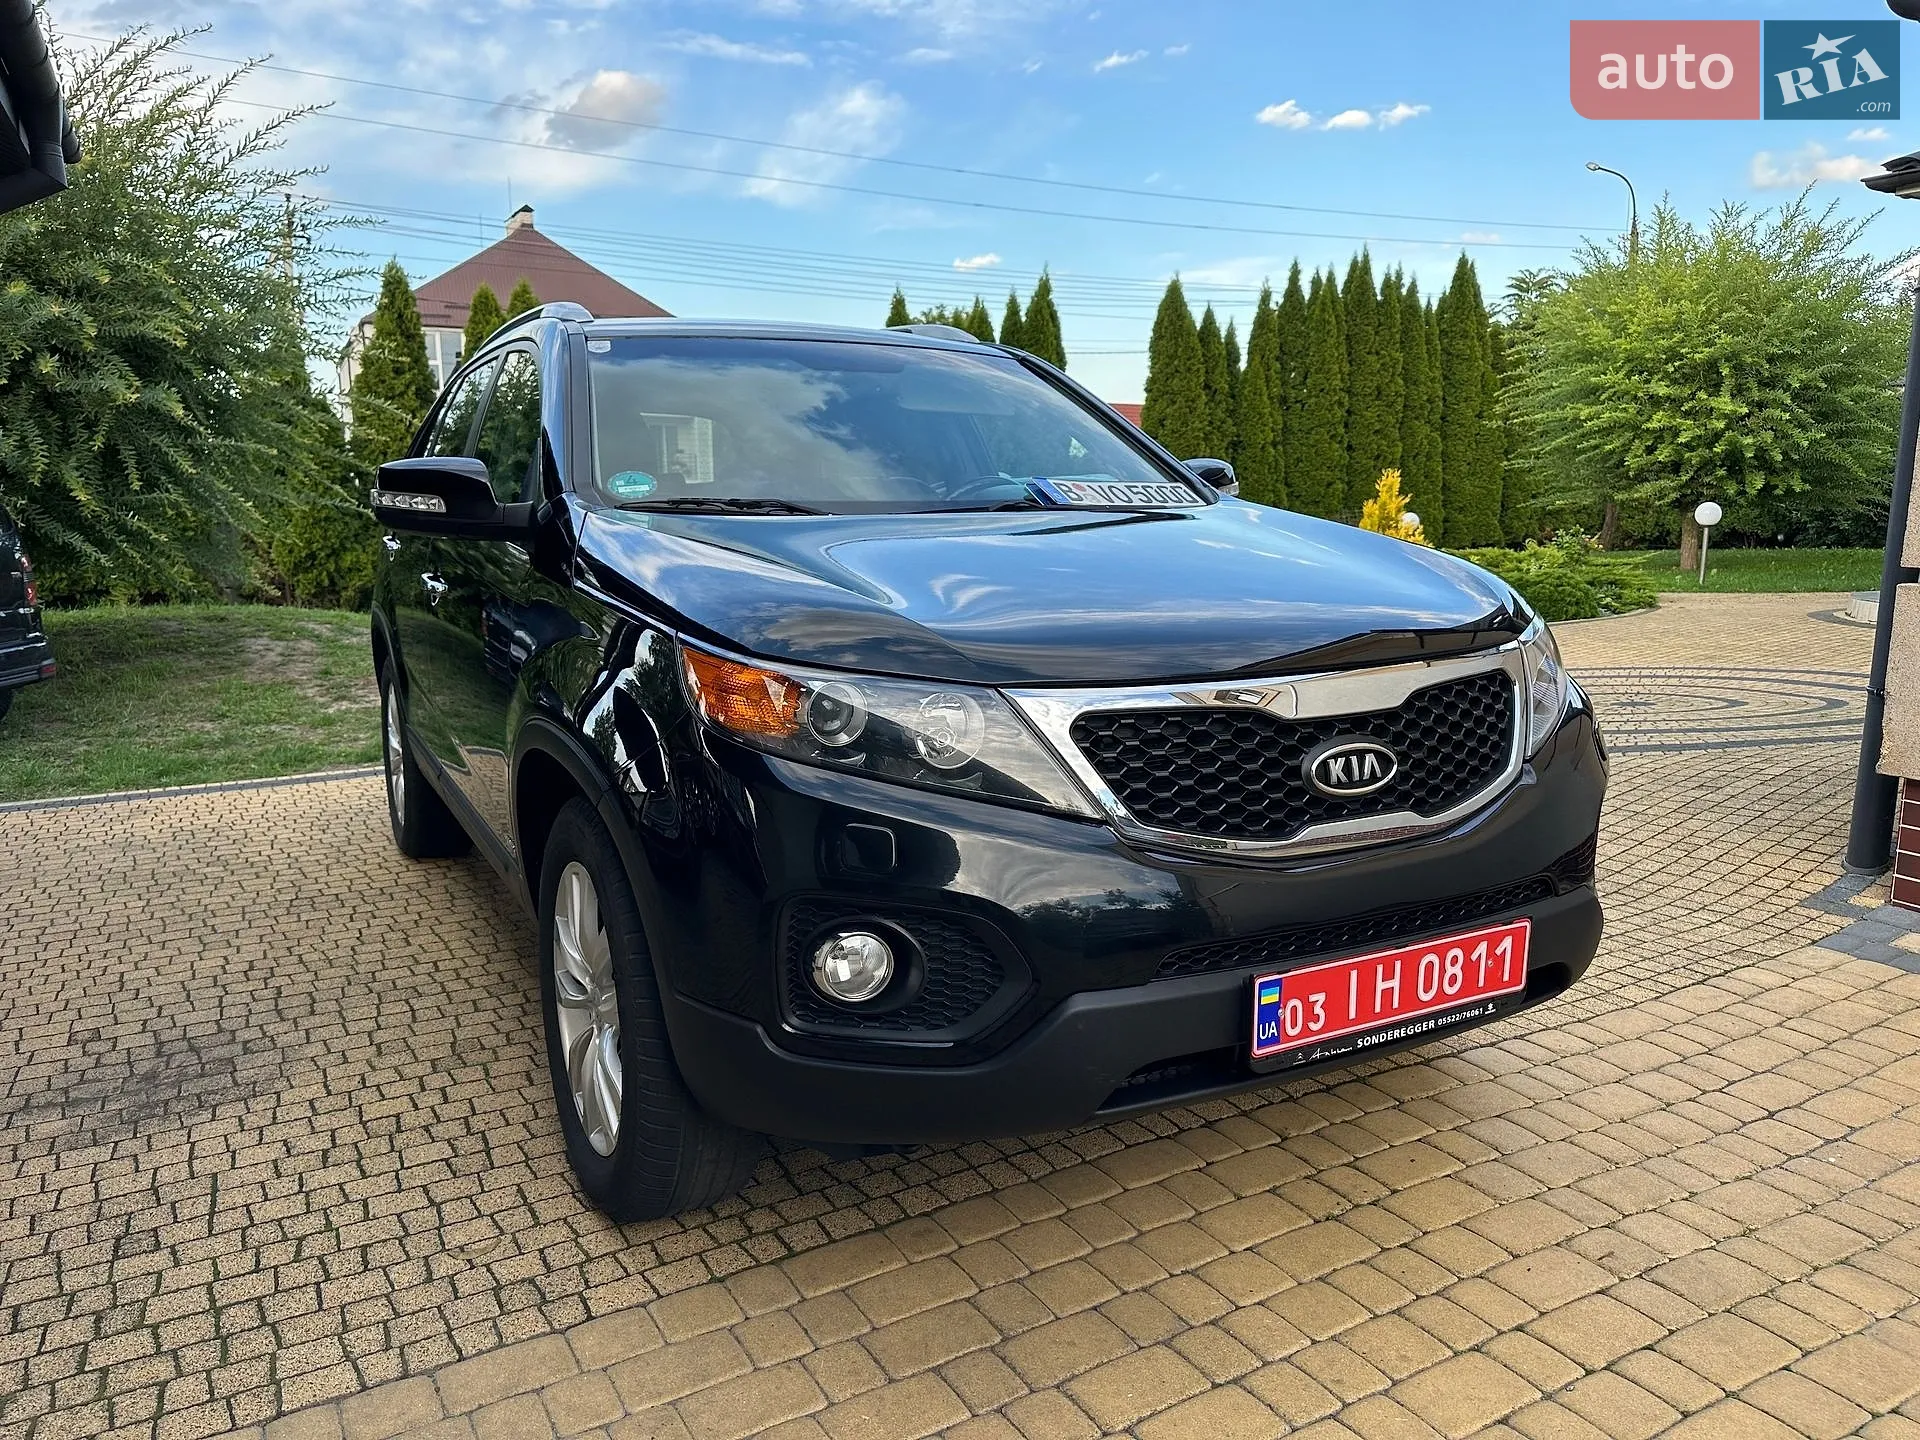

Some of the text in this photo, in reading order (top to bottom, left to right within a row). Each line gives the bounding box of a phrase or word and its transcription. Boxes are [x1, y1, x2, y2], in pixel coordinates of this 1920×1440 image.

[1053, 482, 1083, 502] B
[1327, 753, 1382, 785] KIA
[1284, 992, 1326, 1037] 03
[1417, 935, 1513, 1002] 0811
[1259, 1021, 1278, 1040] UA
[1357, 1019, 1435, 1048] SONDEREGGER
